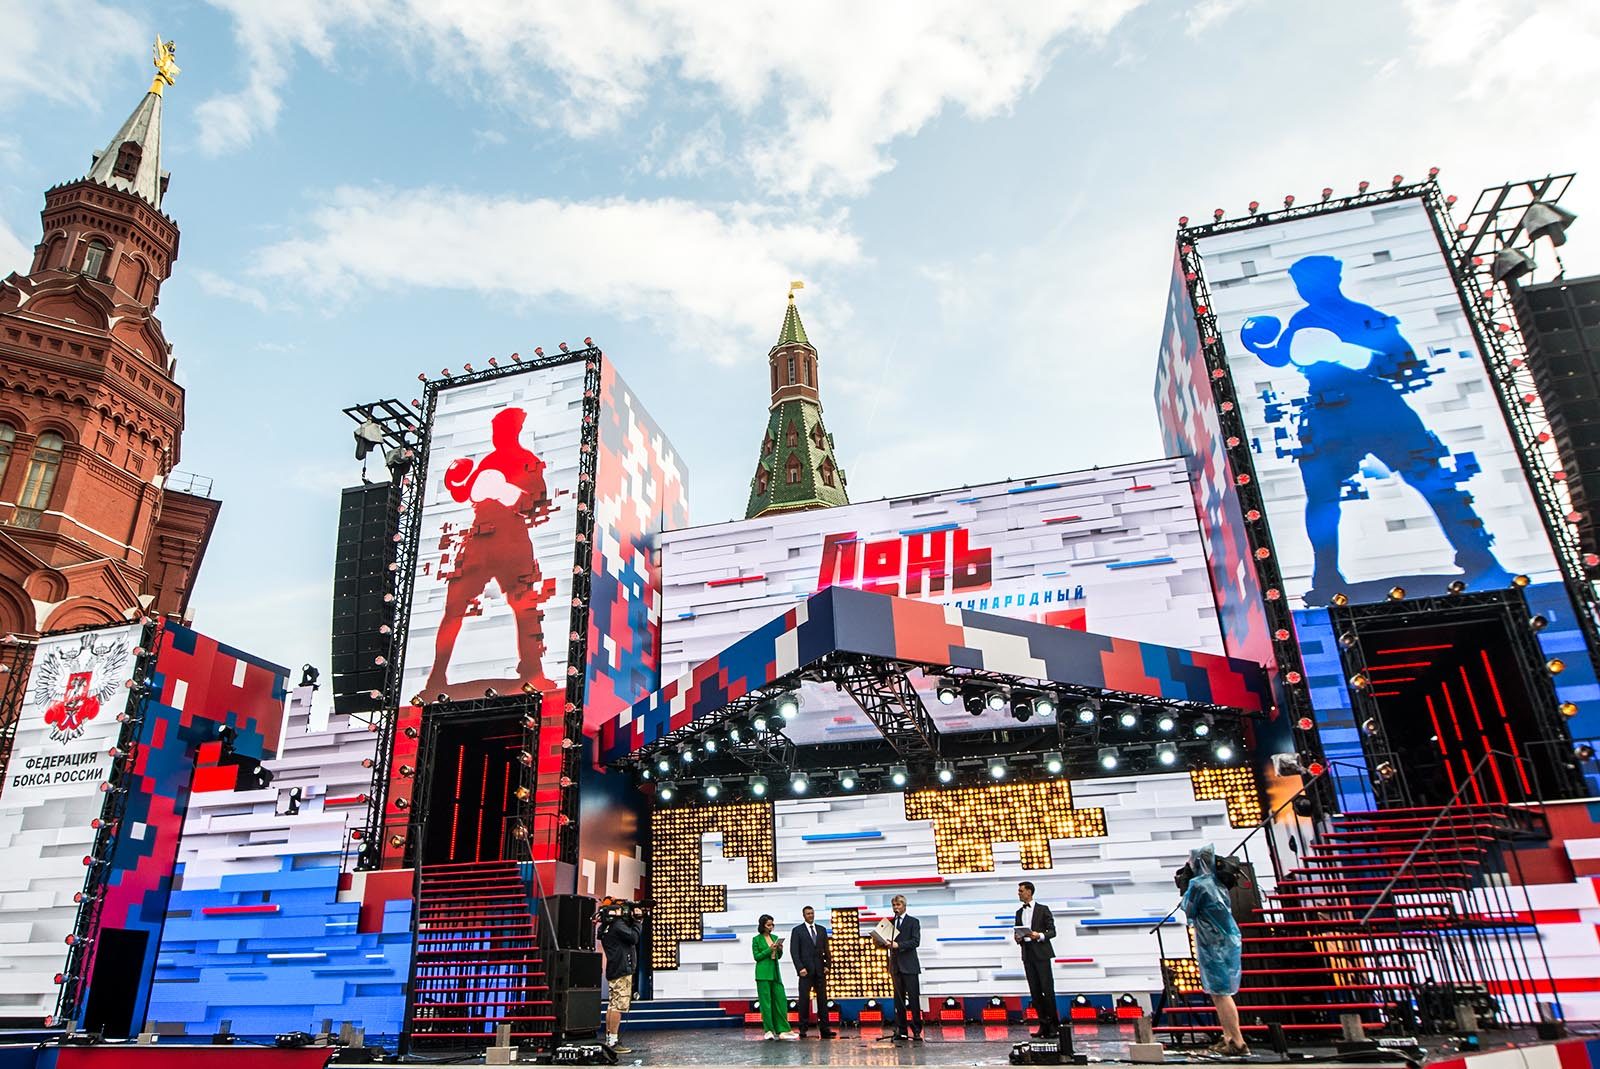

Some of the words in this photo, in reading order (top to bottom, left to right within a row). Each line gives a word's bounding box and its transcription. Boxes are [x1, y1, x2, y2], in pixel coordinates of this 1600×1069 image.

[25, 751, 98, 770] ФЕДЕРАЦИЯ
[12, 773, 51, 787] БОКСА
[53, 767, 104, 783] РОССИИ
